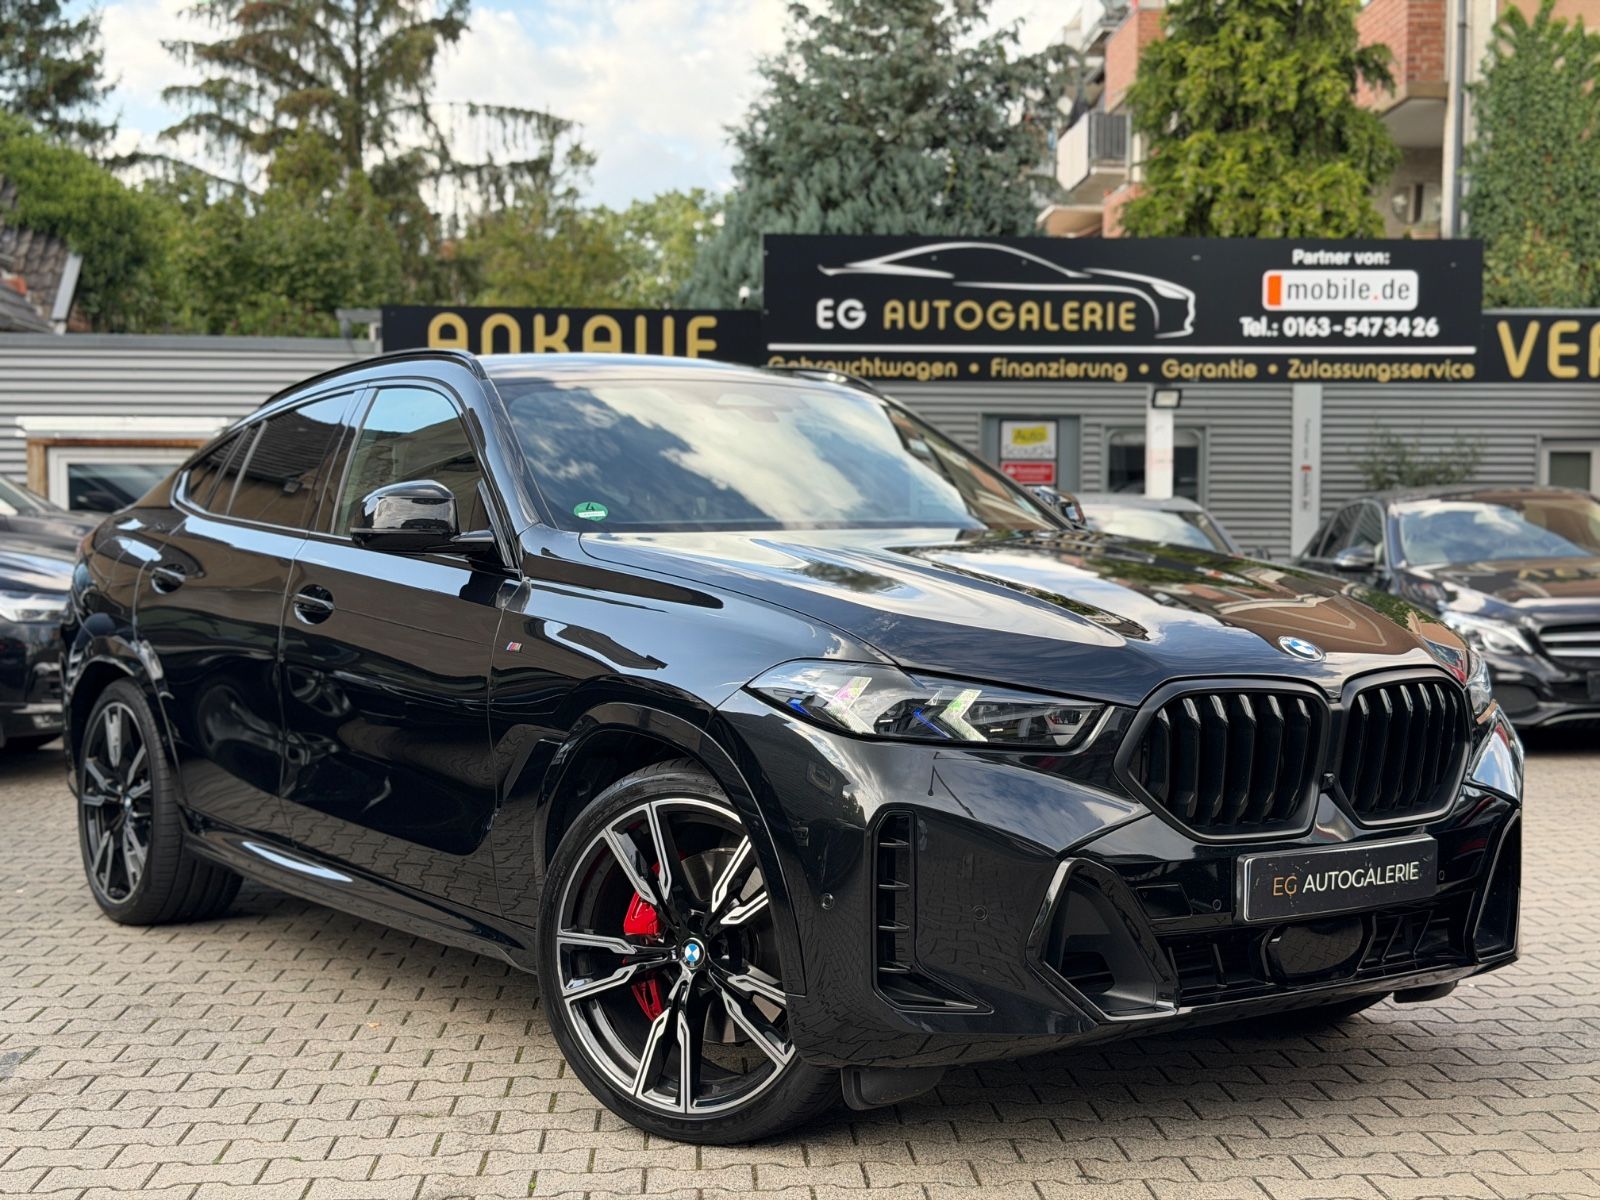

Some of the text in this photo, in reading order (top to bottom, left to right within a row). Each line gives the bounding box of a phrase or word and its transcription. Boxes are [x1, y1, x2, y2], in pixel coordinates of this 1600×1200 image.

[1292, 249, 1391, 266] Partner von:
[1287, 278, 1410, 301] mobile.de
[816, 299, 1137, 332] EG AUTOGALERIE
[1239, 316, 1440, 338] Tel.: 0163-5473426
[990, 357, 1129, 382] Finanzierung
[1161, 359, 1258, 379] Garantie
[1287, 359, 1476, 383] Zulassungsservice
[1272, 861, 1420, 897] EG AUTOGALERIE
